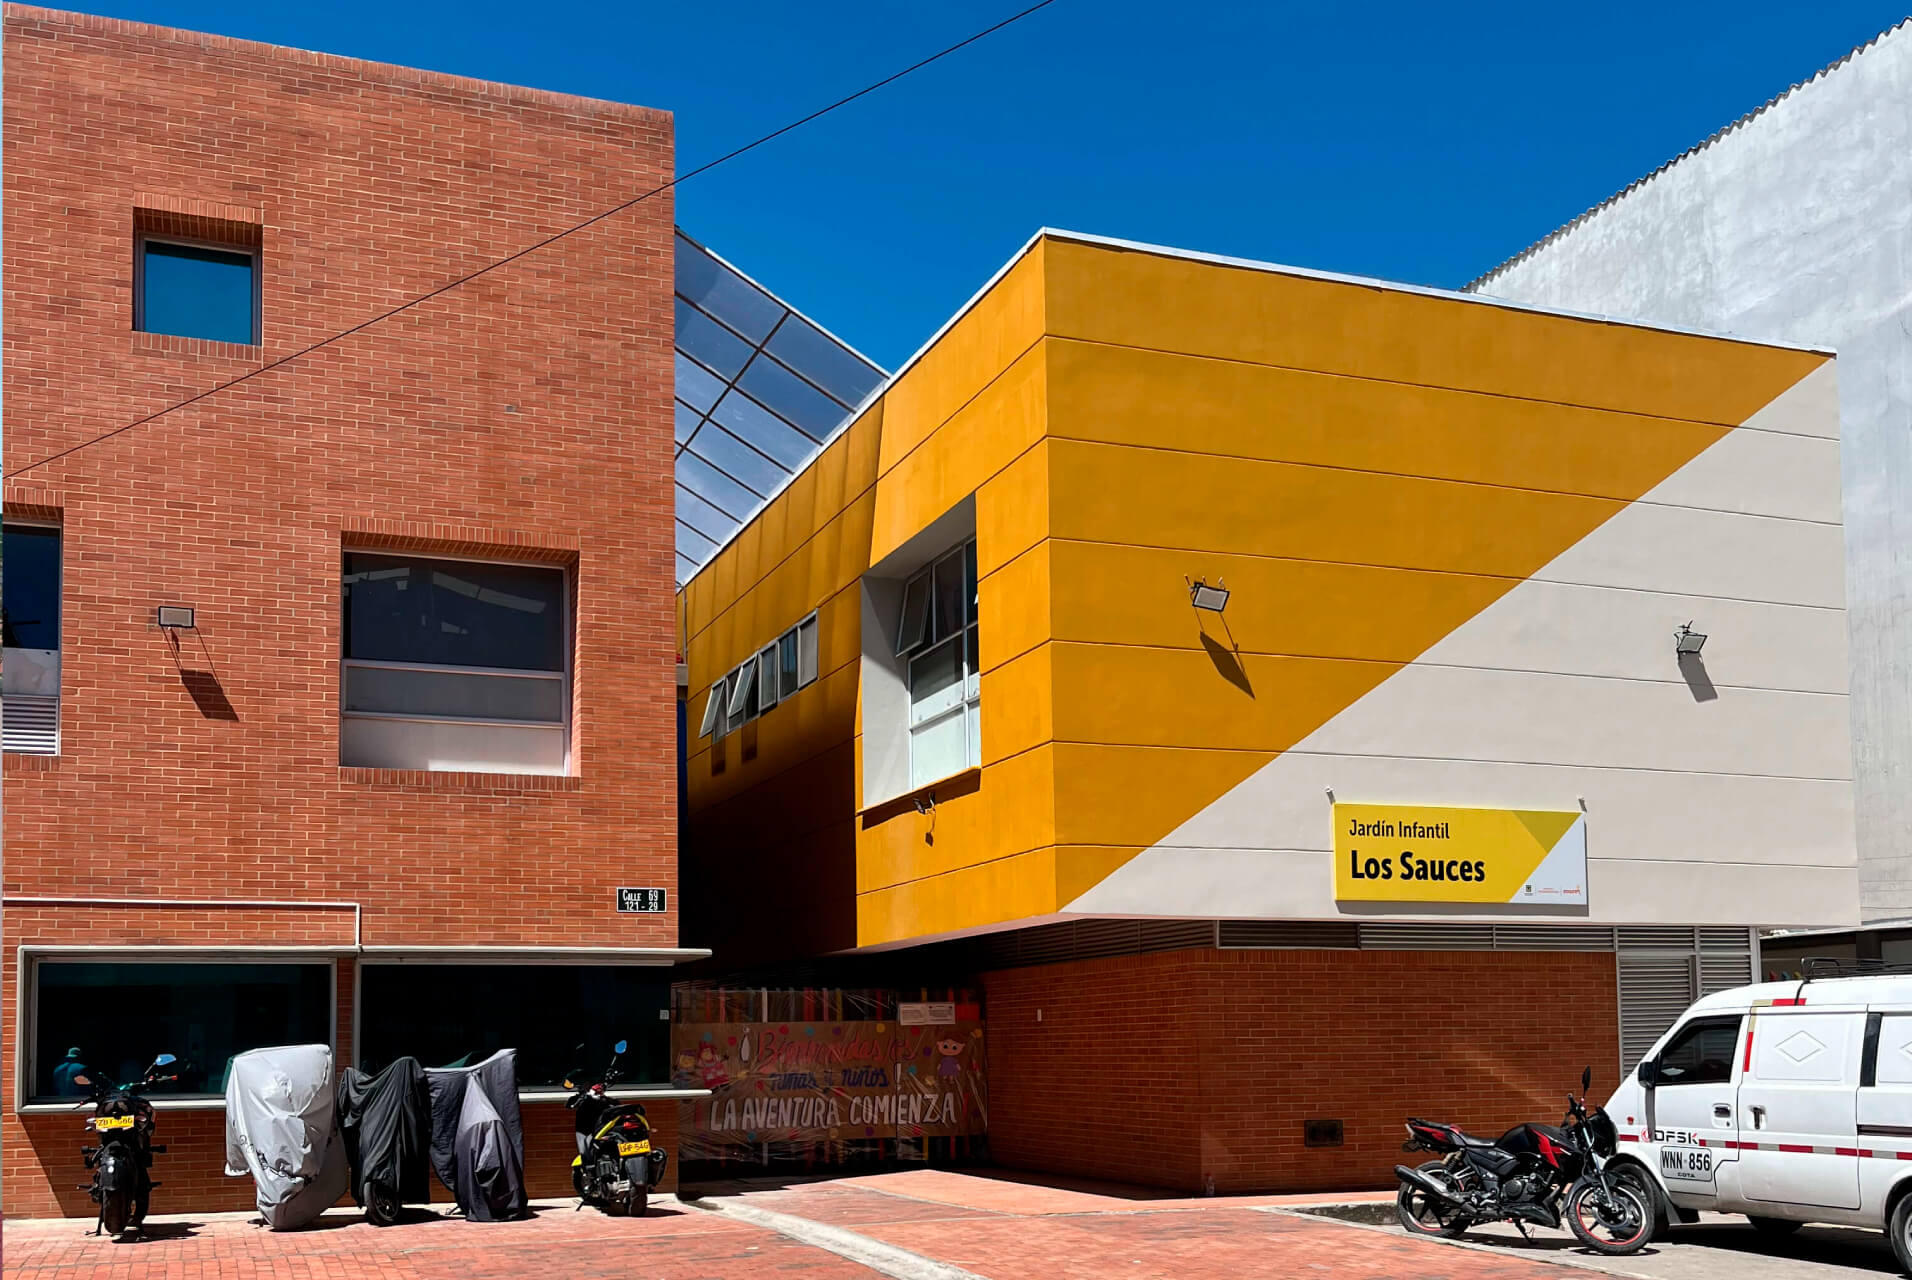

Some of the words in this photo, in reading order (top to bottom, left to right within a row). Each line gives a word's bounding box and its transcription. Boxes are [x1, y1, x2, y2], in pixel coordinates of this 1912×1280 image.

[1349, 819, 1394, 837] Jardín
[1399, 820, 1450, 839] Infantil
[1351, 849, 1393, 880] Los
[1399, 851, 1486, 882] Sauces
[648, 889, 659, 902] 69
[648, 901, 659, 911] 29
[710, 1097, 736, 1131] LA
[741, 1096, 841, 1131] AVENTURA
[849, 1092, 958, 1126] COMIENZA
[1654, 1130, 1698, 1144] DFSK
